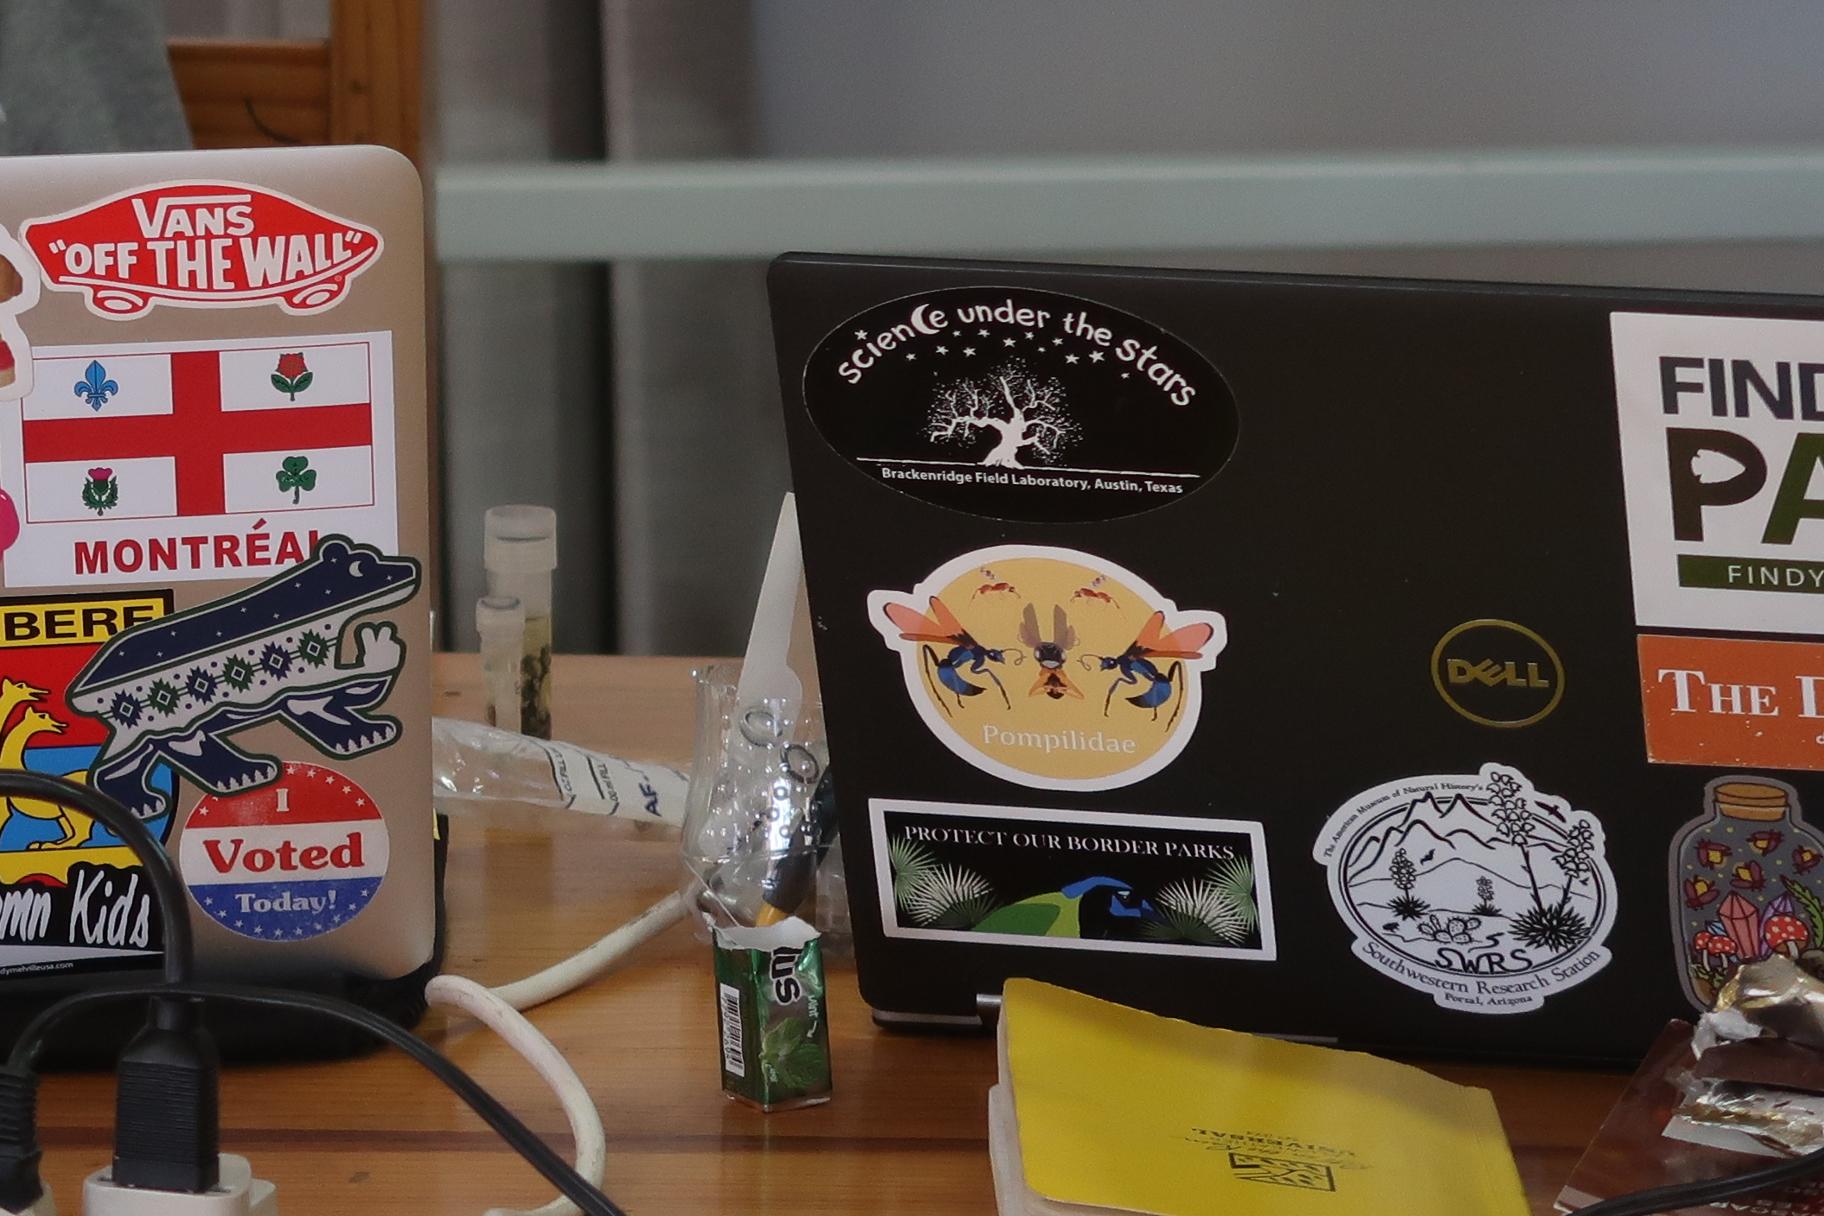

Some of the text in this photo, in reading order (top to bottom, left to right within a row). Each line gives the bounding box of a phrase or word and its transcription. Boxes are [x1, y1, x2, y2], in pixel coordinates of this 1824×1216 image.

[131, 194, 255, 239] VANS
[147, 241, 236, 290] THE
[958, 299, 1051, 328] under
[1062, 311, 1113, 347] the
[882, 467, 1183, 495] Brackenridge Field Laboratory, Austin, Texas
[1447, 657, 1549, 688] DELL
[982, 724, 1137, 755] Pompilidae
[275, 787, 290, 814] I
[1333, 813, 1359, 844] American
[1356, 794, 1390, 815] Museum
[1391, 789, 1401, 798] of
[1403, 783, 1439, 795] Natural
[202, 831, 366, 875] Voted
[904, 824, 1234, 861] PROTECT OUR BORDER PARKS
[68, 868, 151, 948] Kids
[234, 889, 337, 916] Today!
[1362, 941, 1601, 996] Southwestern Research Station
[1434, 946, 1534, 975] SWRS
[1445, 992, 1534, 1007] Portal, Arizona
